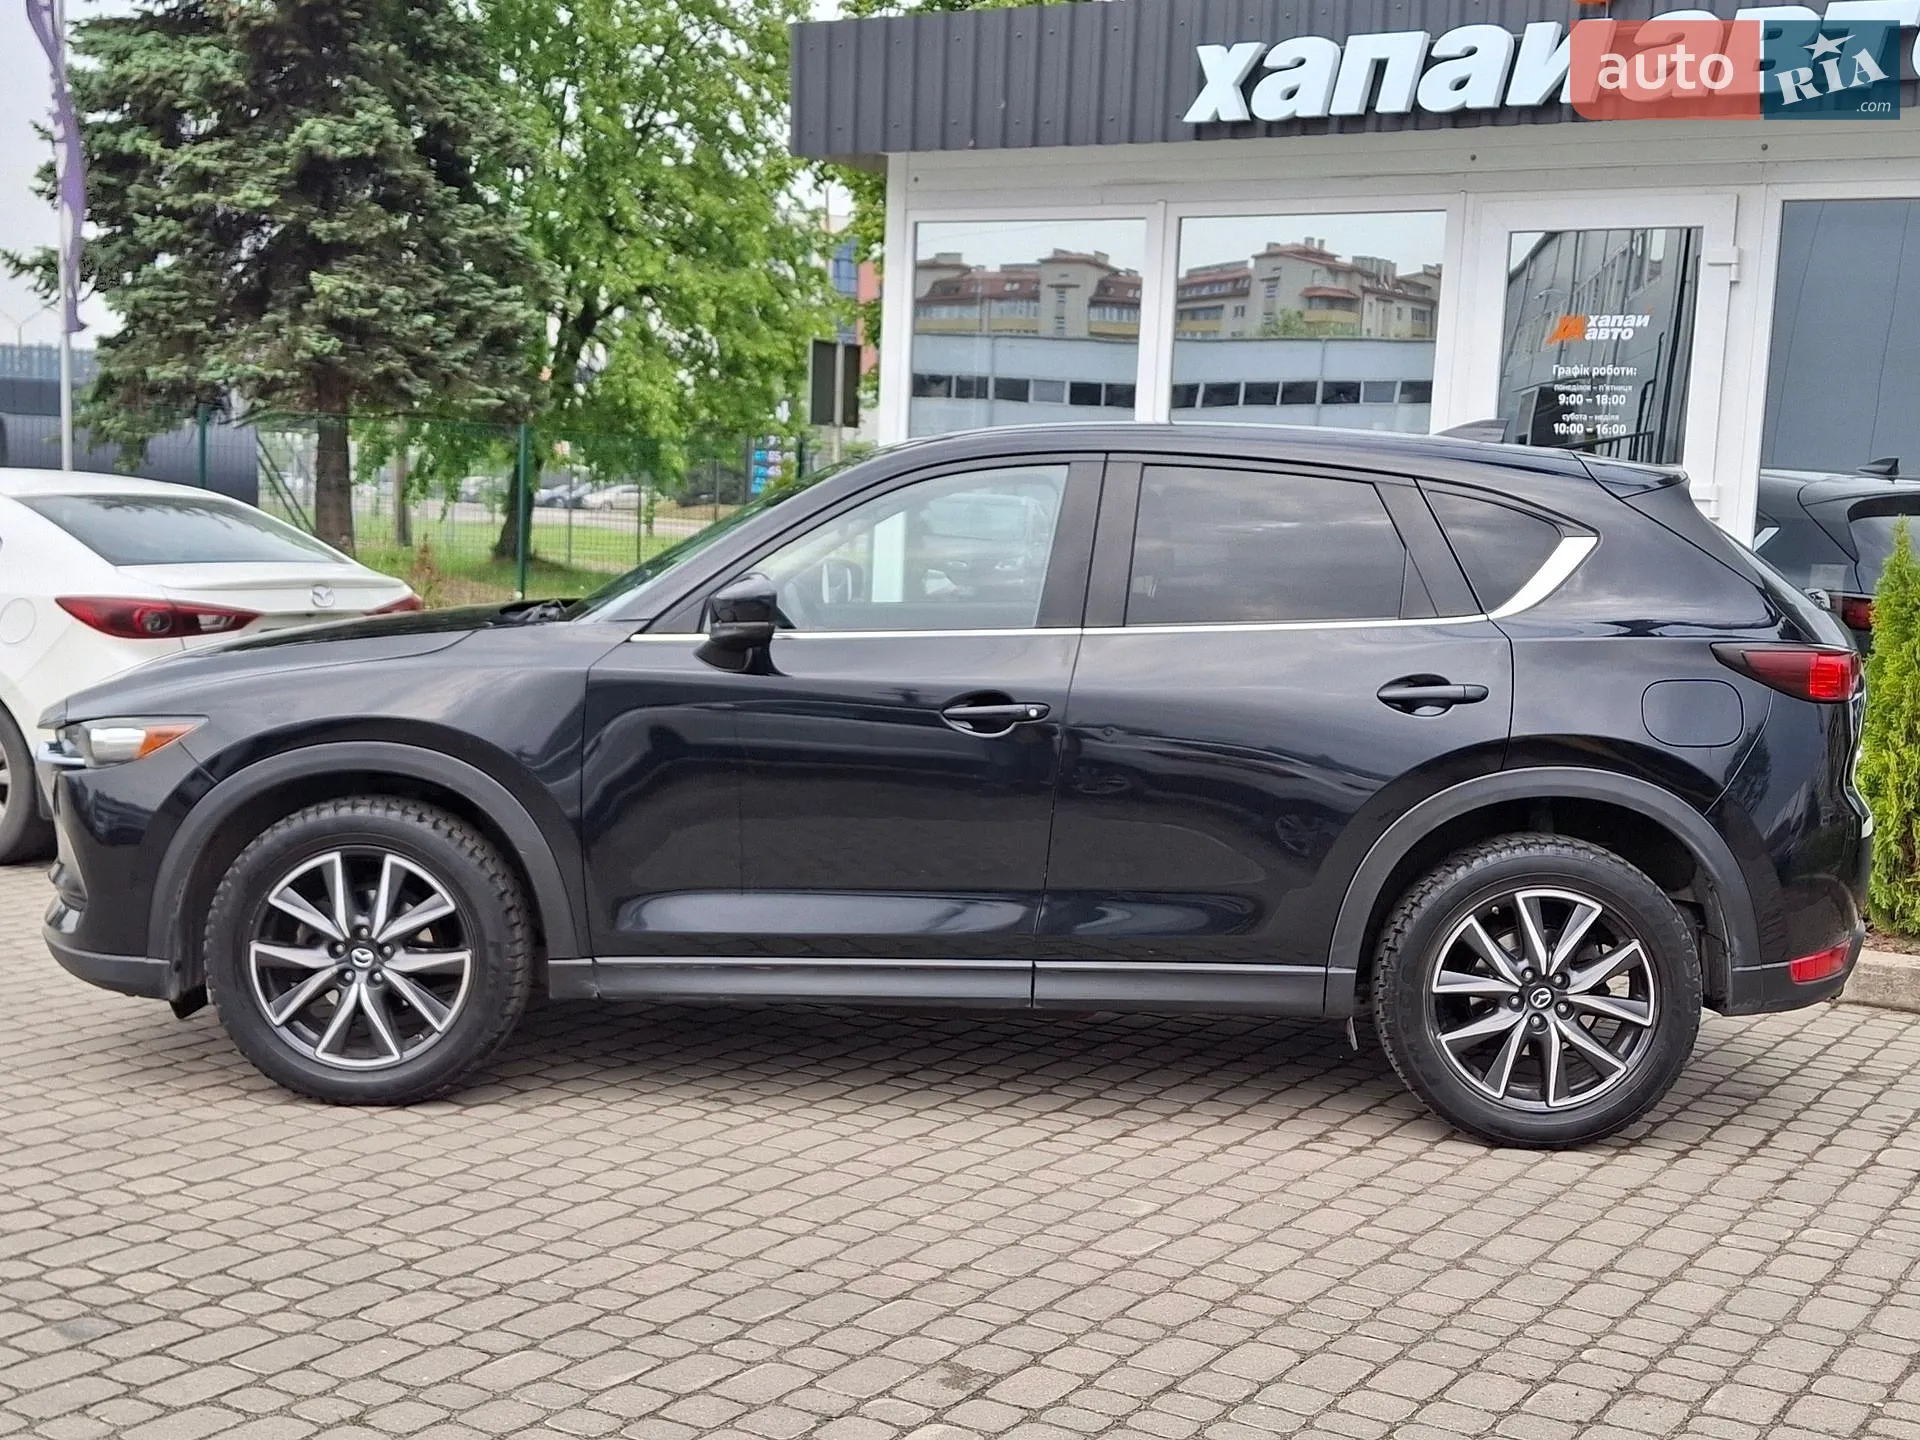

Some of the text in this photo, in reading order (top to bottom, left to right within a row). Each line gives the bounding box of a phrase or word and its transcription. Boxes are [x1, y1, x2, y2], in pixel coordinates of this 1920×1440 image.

[1619, 0, 1920, 104] авт
[1584, 327, 1634, 341] авто
[1552, 364, 1637, 378] Графік роботи:
[1558, 393, 1584, 406] 9:00
[1595, 393, 1626, 406] 18:00
[1561, 412, 1588, 422] субота
[1553, 422, 1584, 435] 10:00
[1595, 423, 1627, 435] 16:00
